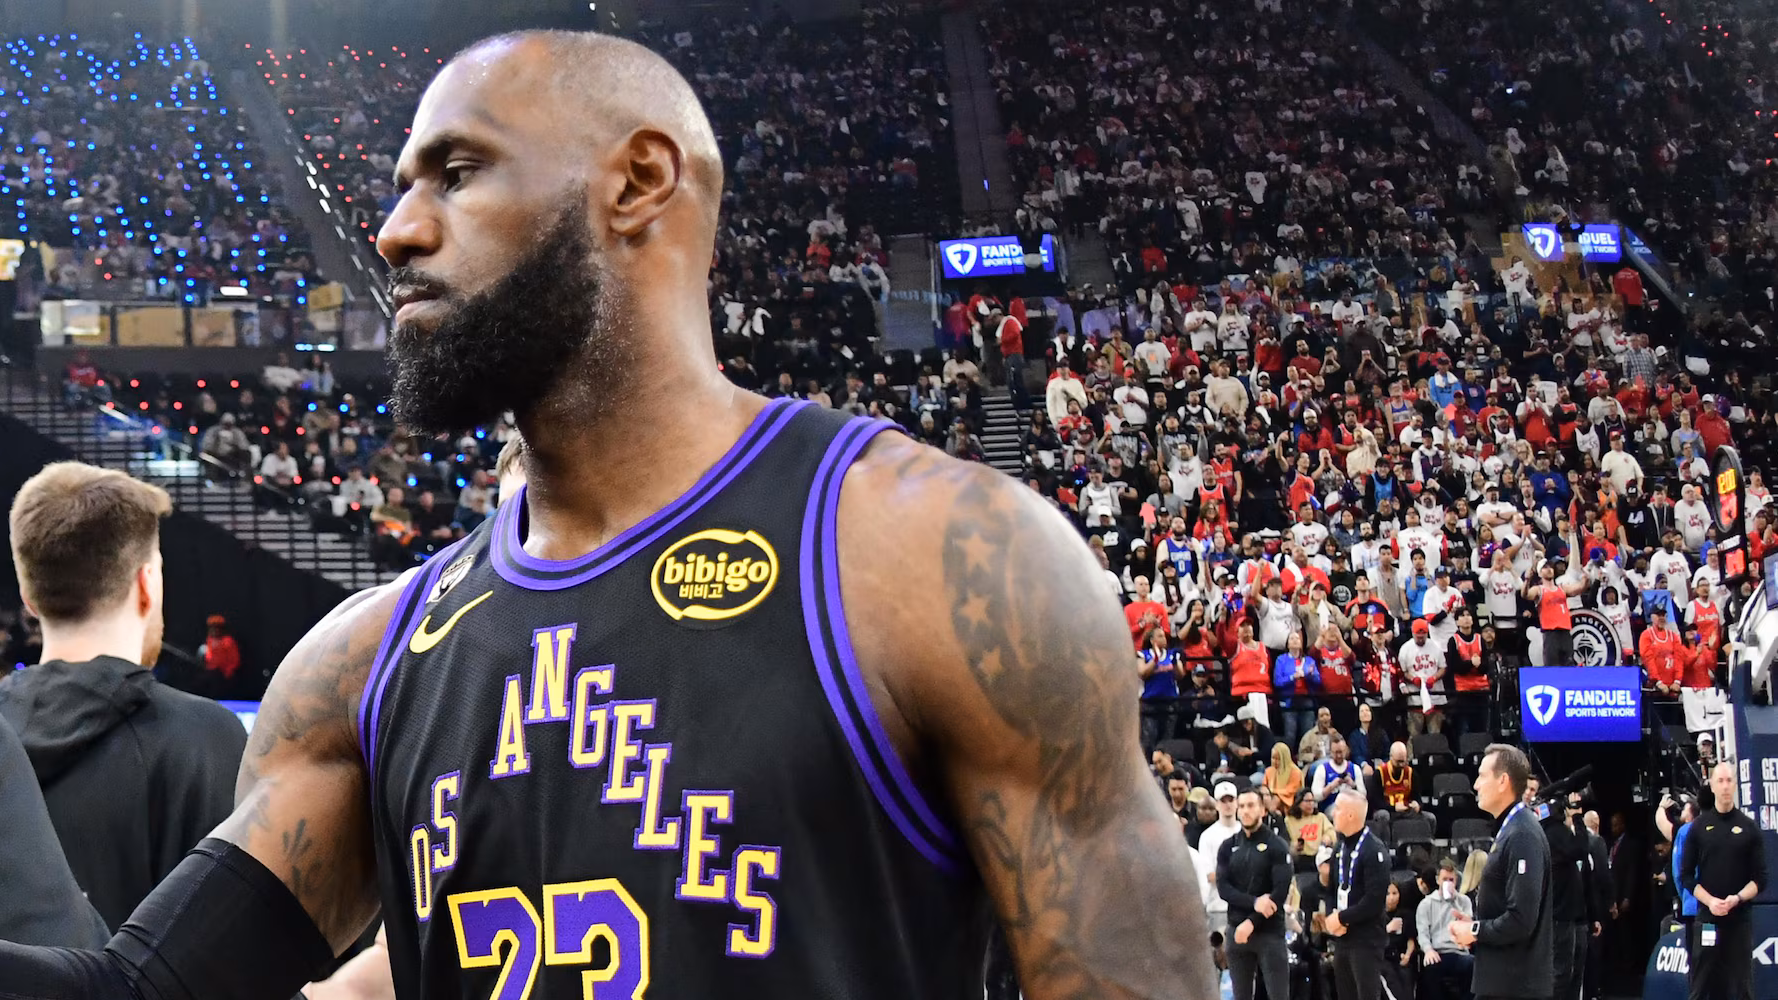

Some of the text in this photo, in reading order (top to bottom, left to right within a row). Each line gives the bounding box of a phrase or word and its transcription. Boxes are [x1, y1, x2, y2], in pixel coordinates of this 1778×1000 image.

[1560, 232, 1617, 245] DUEL
[981, 244, 1048, 258] FANDL
[663, 551, 770, 593] bibigo
[678, 583, 723, 600] 비비고
[1575, 616, 1612, 643] ANGELES
[1564, 689, 1636, 706] FANDUEL
[1565, 707, 1636, 717] SPORTS NETWORK
[1762, 757, 1778, 781] GE
[410, 622, 781, 959] OS ANGELES
[1656, 938, 1690, 975] coin
